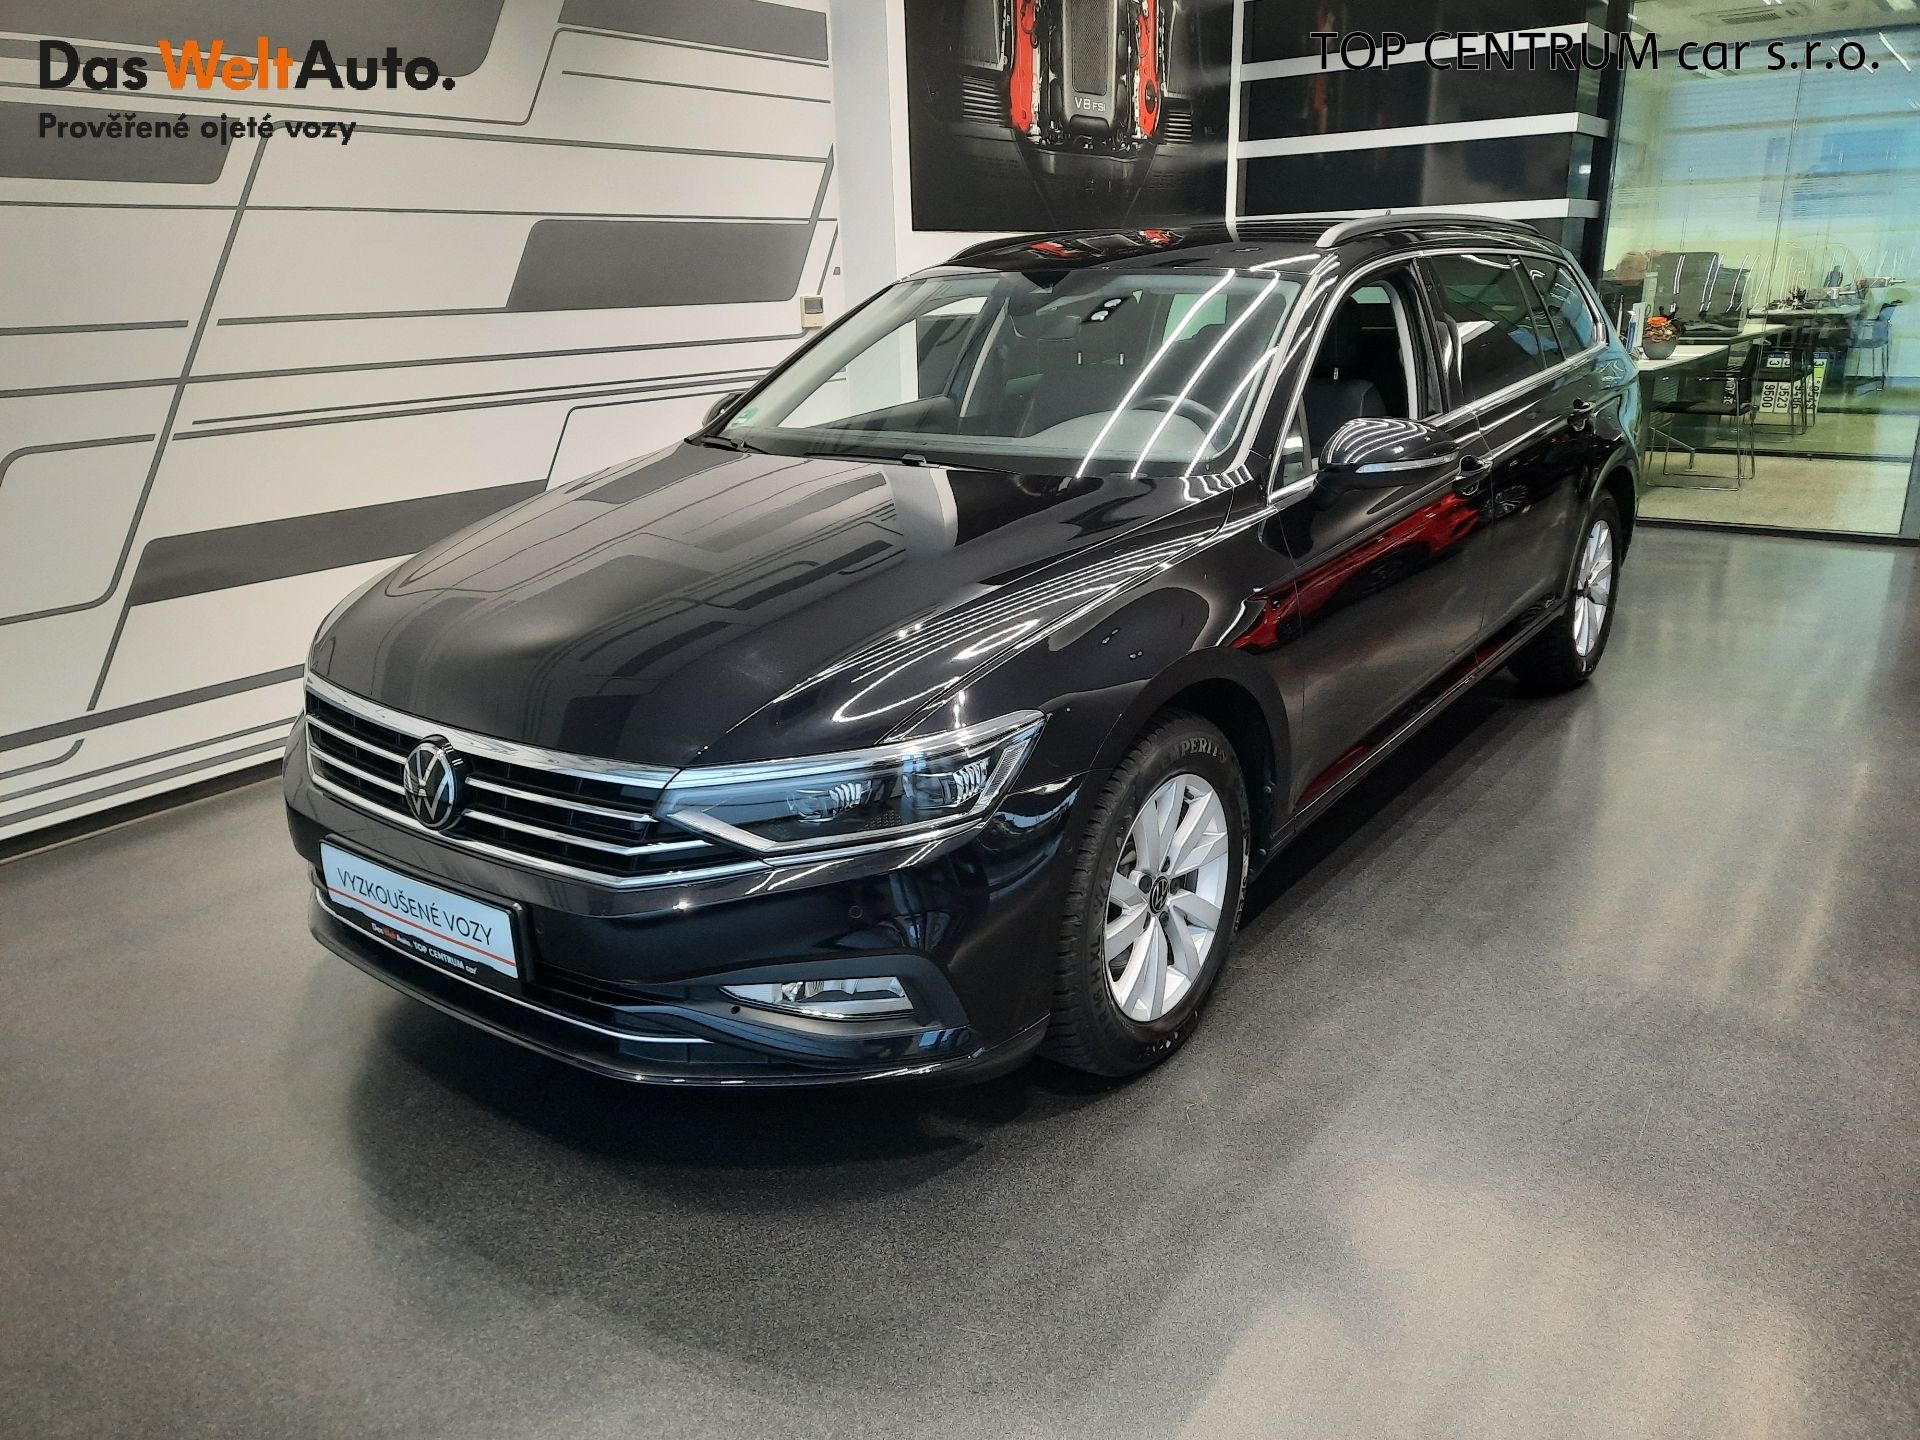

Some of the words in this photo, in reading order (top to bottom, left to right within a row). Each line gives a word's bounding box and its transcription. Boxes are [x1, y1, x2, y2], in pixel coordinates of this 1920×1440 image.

[1074, 96, 1091, 110] V8
[1092, 102, 1106, 112] FSI
[337, 867, 442, 928] VYZKOUŠENÉ
[443, 910, 493, 946] VOZY
[412, 940, 428, 954] TOP
[428, 948, 465, 971] CENTRUM
